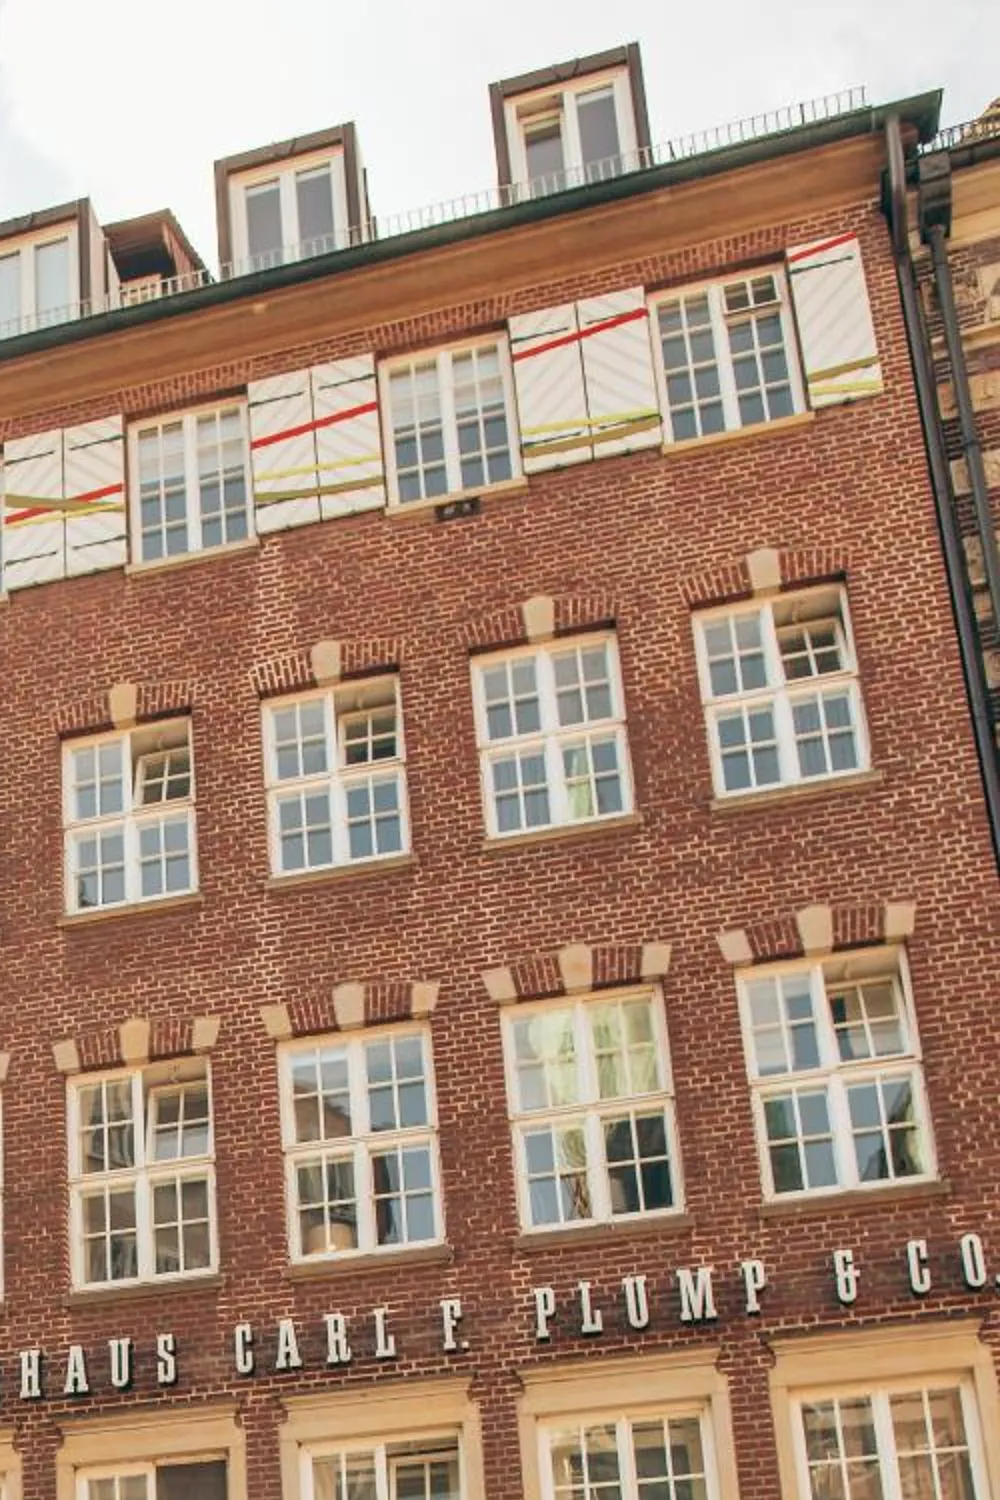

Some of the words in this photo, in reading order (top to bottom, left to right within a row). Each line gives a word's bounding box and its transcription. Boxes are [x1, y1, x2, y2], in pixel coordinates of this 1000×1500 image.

[234, 1307, 395, 1374] CARL
[440, 1299, 470, 1350] F.
[534, 1259, 766, 1339] PLUMP
[833, 1249, 860, 1302] &
